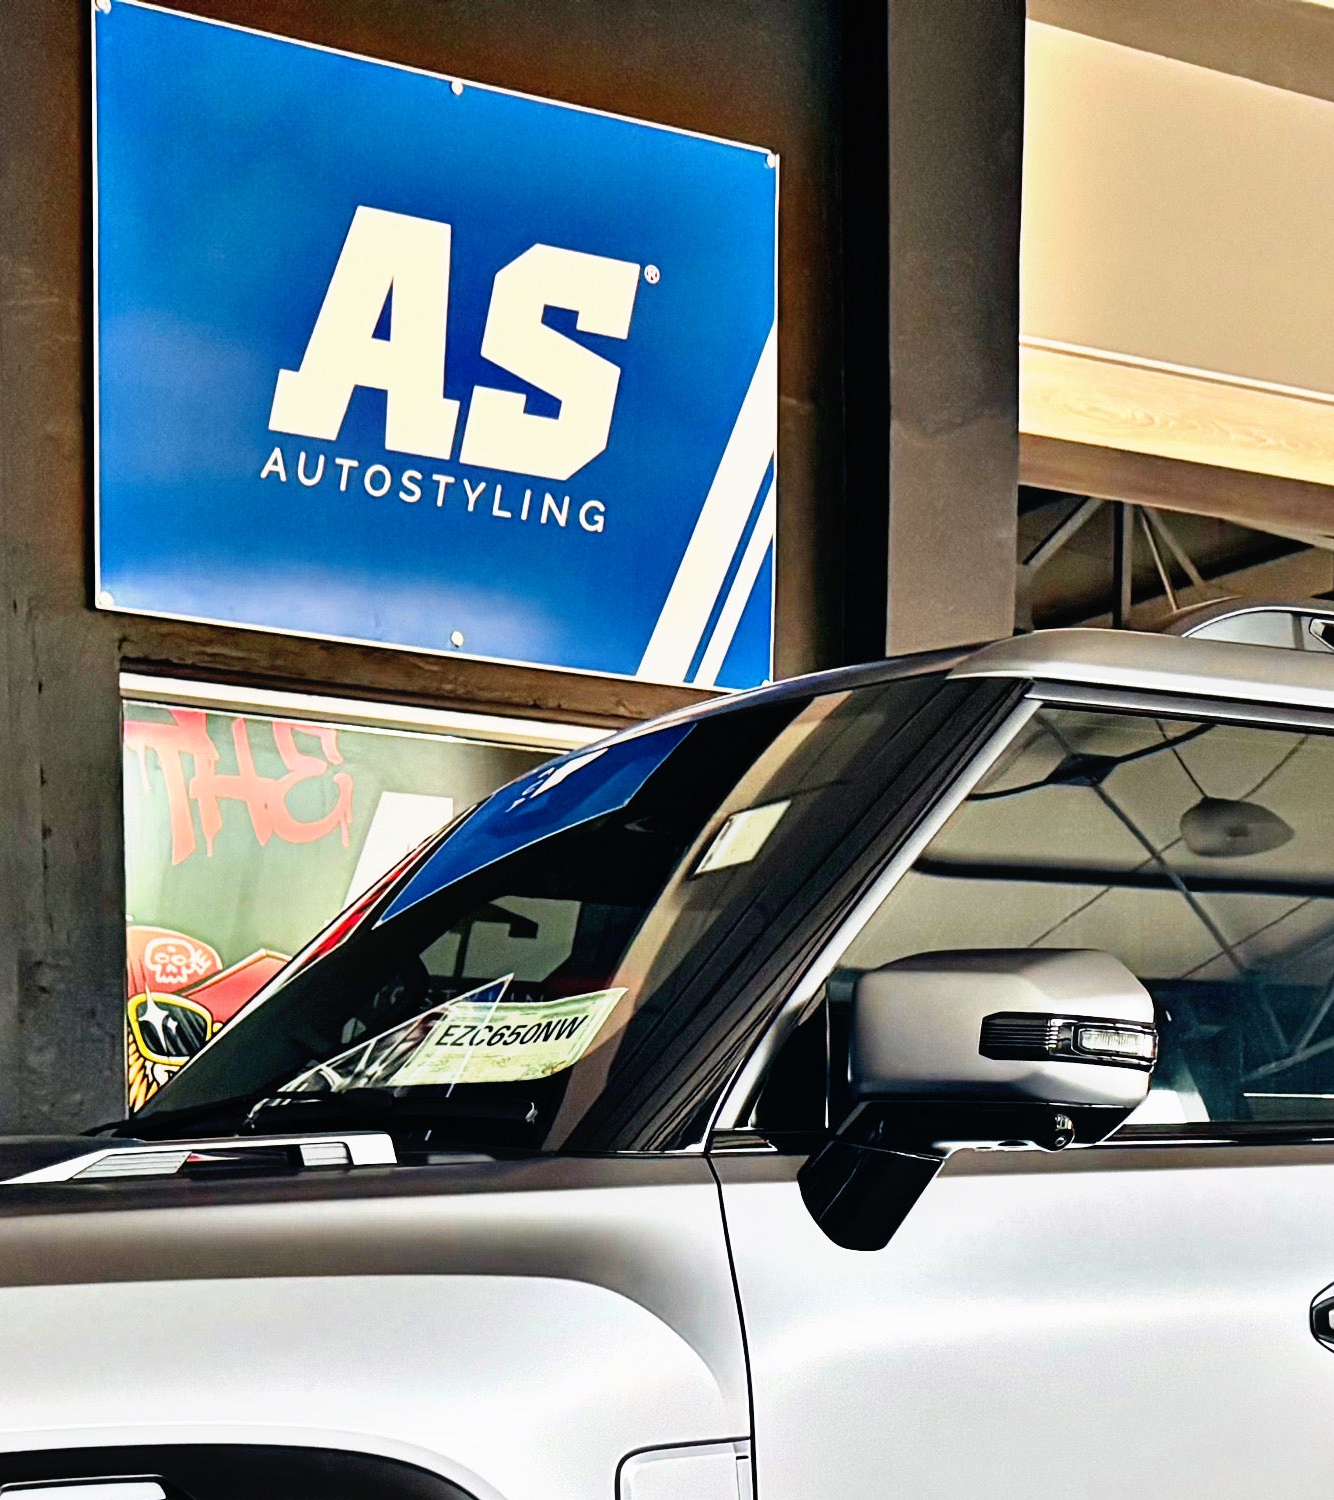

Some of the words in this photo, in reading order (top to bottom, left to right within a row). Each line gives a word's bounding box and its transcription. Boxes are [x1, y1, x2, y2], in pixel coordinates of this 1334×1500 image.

[267, 204, 642, 482] AS
[260, 446, 607, 534] AUTOSTYLING
[123, 708, 355, 867] THE
[434, 1014, 590, 1047] EZC650NW
